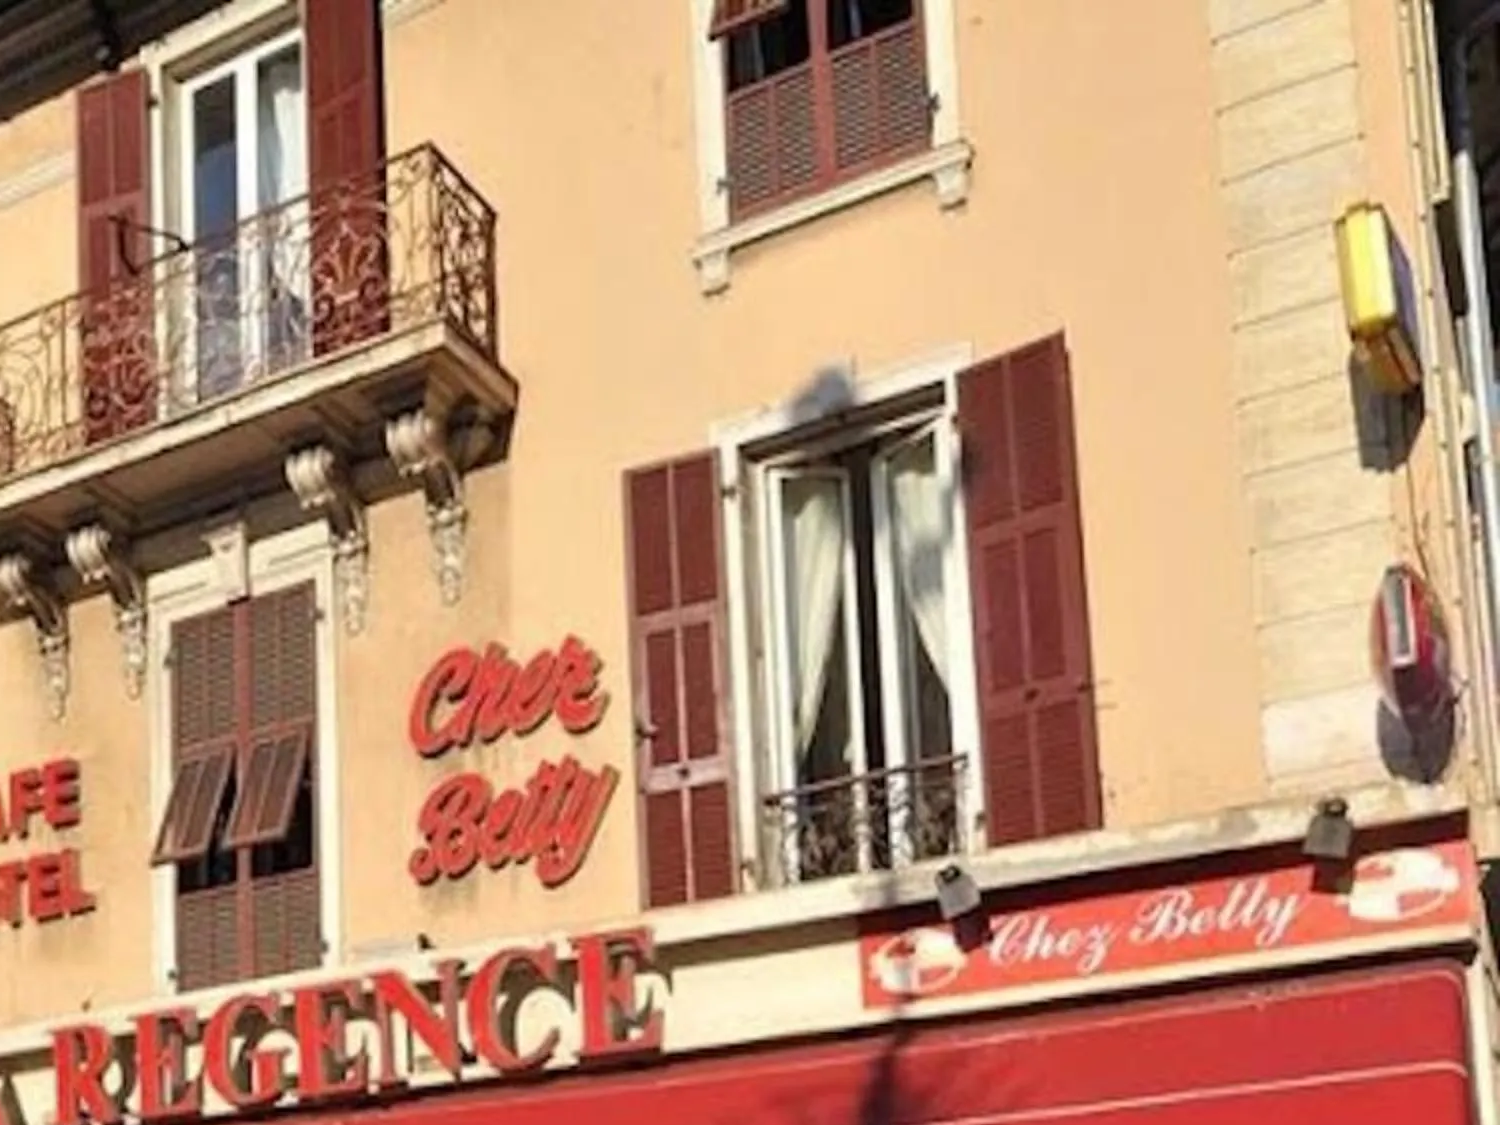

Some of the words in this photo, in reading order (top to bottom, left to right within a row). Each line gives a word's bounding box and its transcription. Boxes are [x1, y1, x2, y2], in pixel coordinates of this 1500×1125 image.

[409, 755, 620, 888] Betty
[989, 913, 1114, 974] Chez
[1129, 879, 1299, 947] Betty
